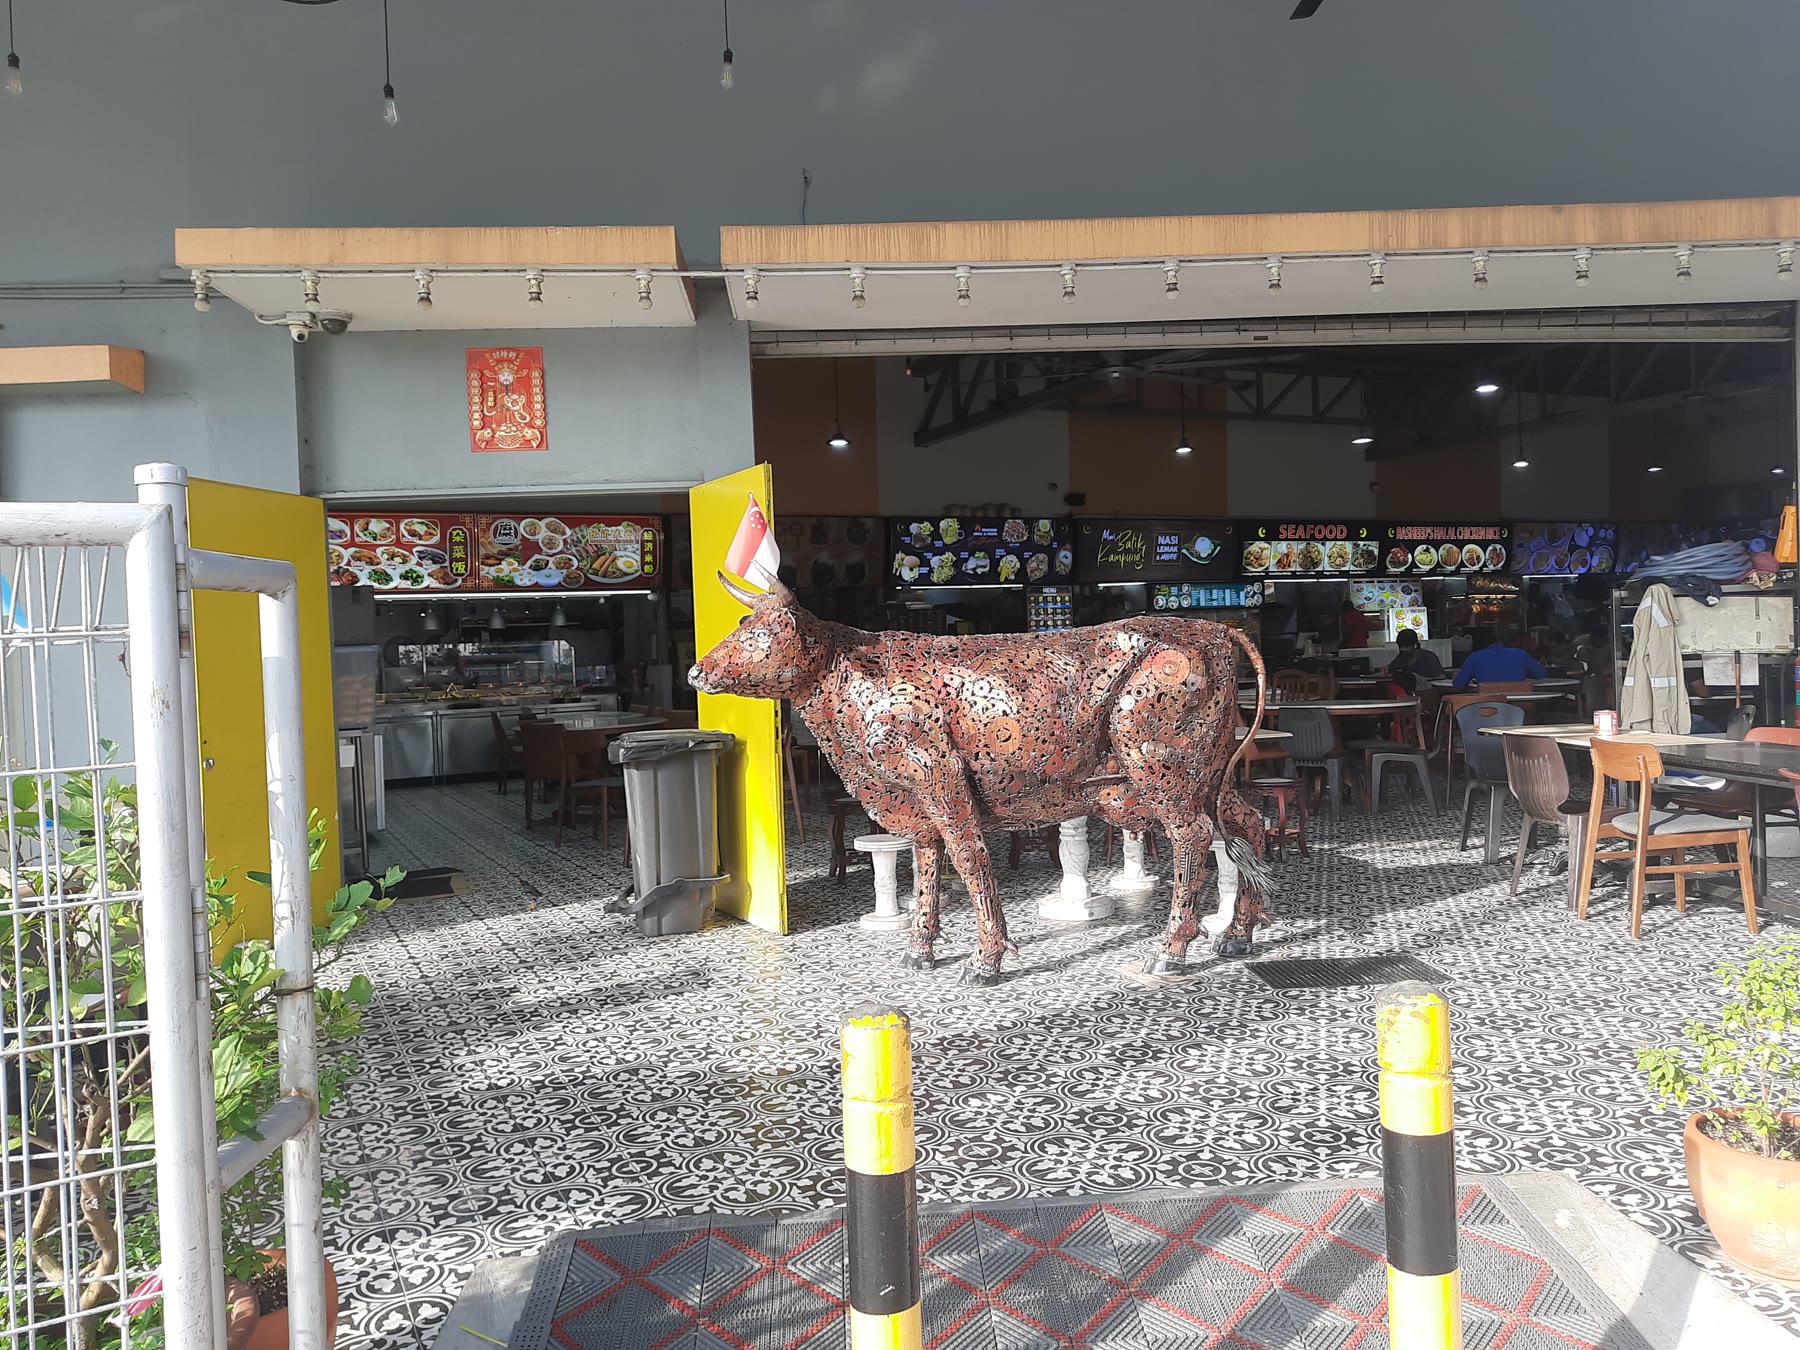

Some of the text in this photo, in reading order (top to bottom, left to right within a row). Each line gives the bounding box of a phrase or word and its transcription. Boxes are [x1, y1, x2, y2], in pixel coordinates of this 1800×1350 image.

[1101, 529, 1146, 552] Mari Balik
[1157, 536, 1178, 545] NASI
[1278, 524, 1348, 539] SEAFOOD
[1396, 526, 1501, 540] RASHEED'S HALAL CHICKEN RICE
[451, 529, 466, 575] 杂菜饭
[643, 530, 654, 574] 经济米粉
